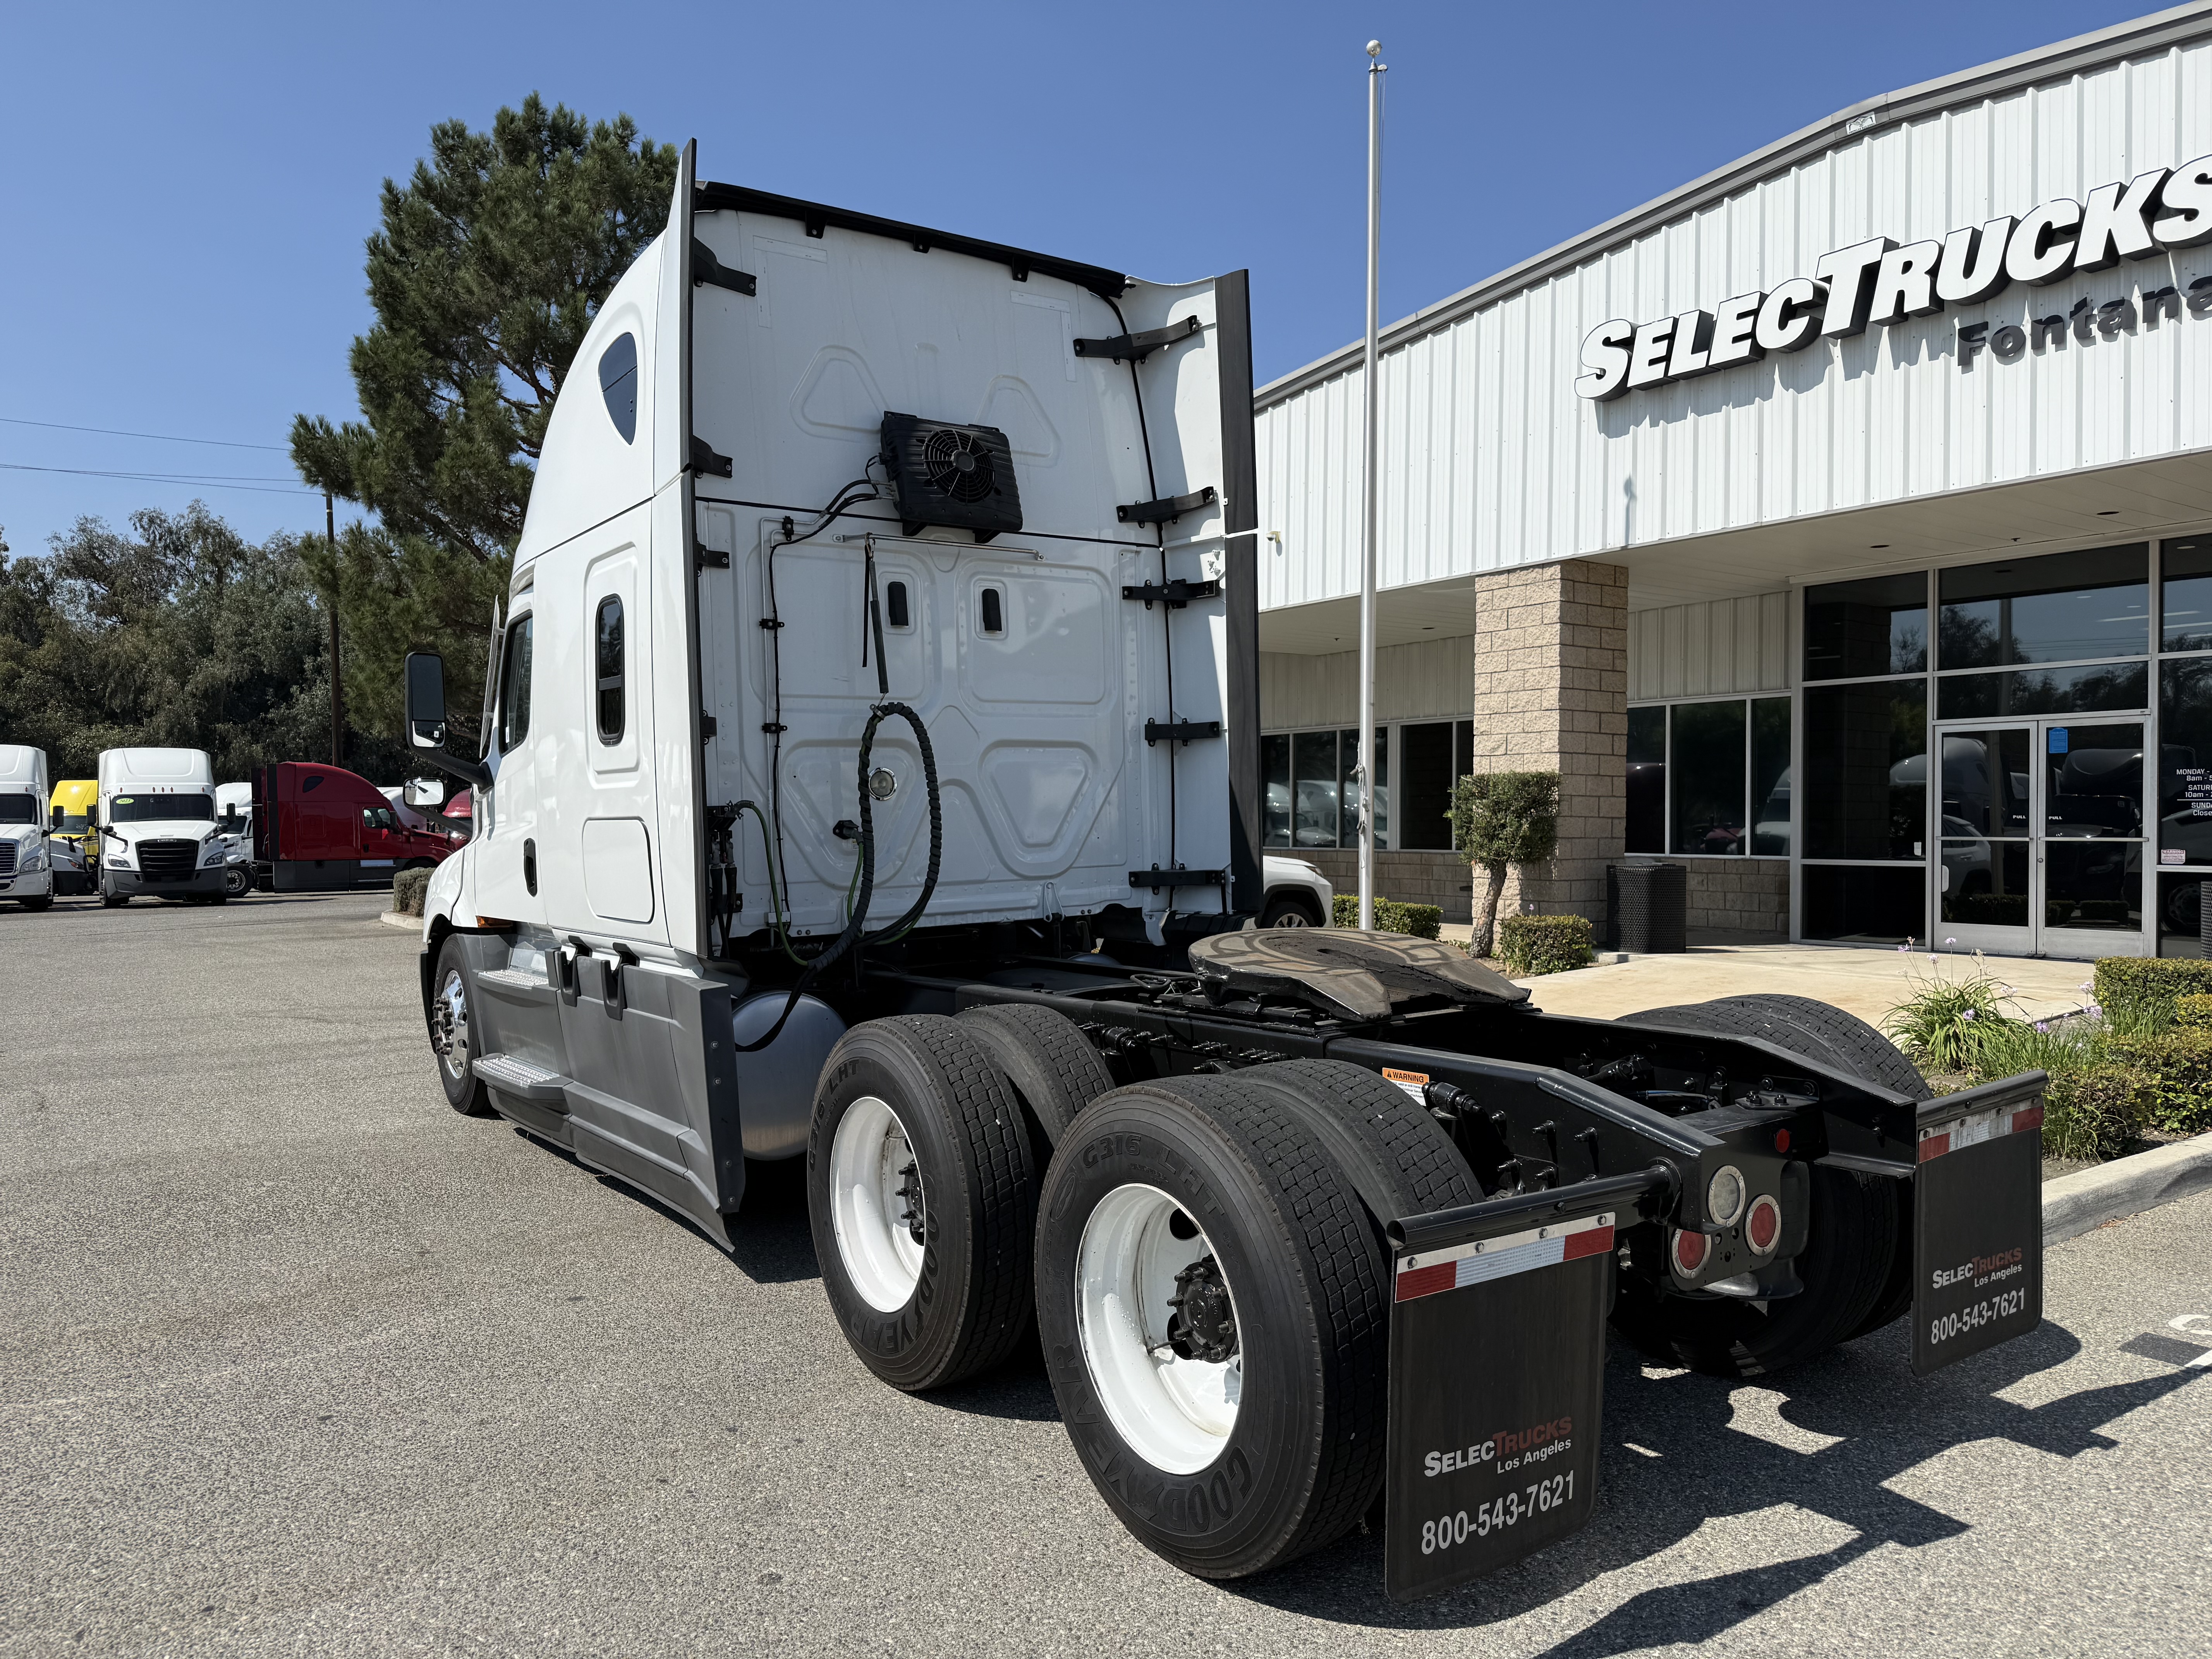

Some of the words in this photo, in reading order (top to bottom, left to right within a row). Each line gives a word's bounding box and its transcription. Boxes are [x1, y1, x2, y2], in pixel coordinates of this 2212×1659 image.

[1393, 1071, 1424, 1083] WARNING
[1082, 1134, 1142, 1168] G316
[1157, 1146, 1225, 1216] LHT
[1933, 1247, 2022, 1289] SELECTRUCKS
[1975, 1276, 1988, 1288] Los
[1990, 1264, 2022, 1281] Angeles
[1931, 1287, 2025, 1344] 800-543-7621
[1053, 1343, 1252, 1533] GOODYEAR
[1424, 1417, 1572, 1477] SELECTRUCKS
[1497, 1458, 1520, 1474] Los
[1523, 1439, 1571, 1465] Angeles
[1421, 1470, 1574, 1555] 800-543-7621
